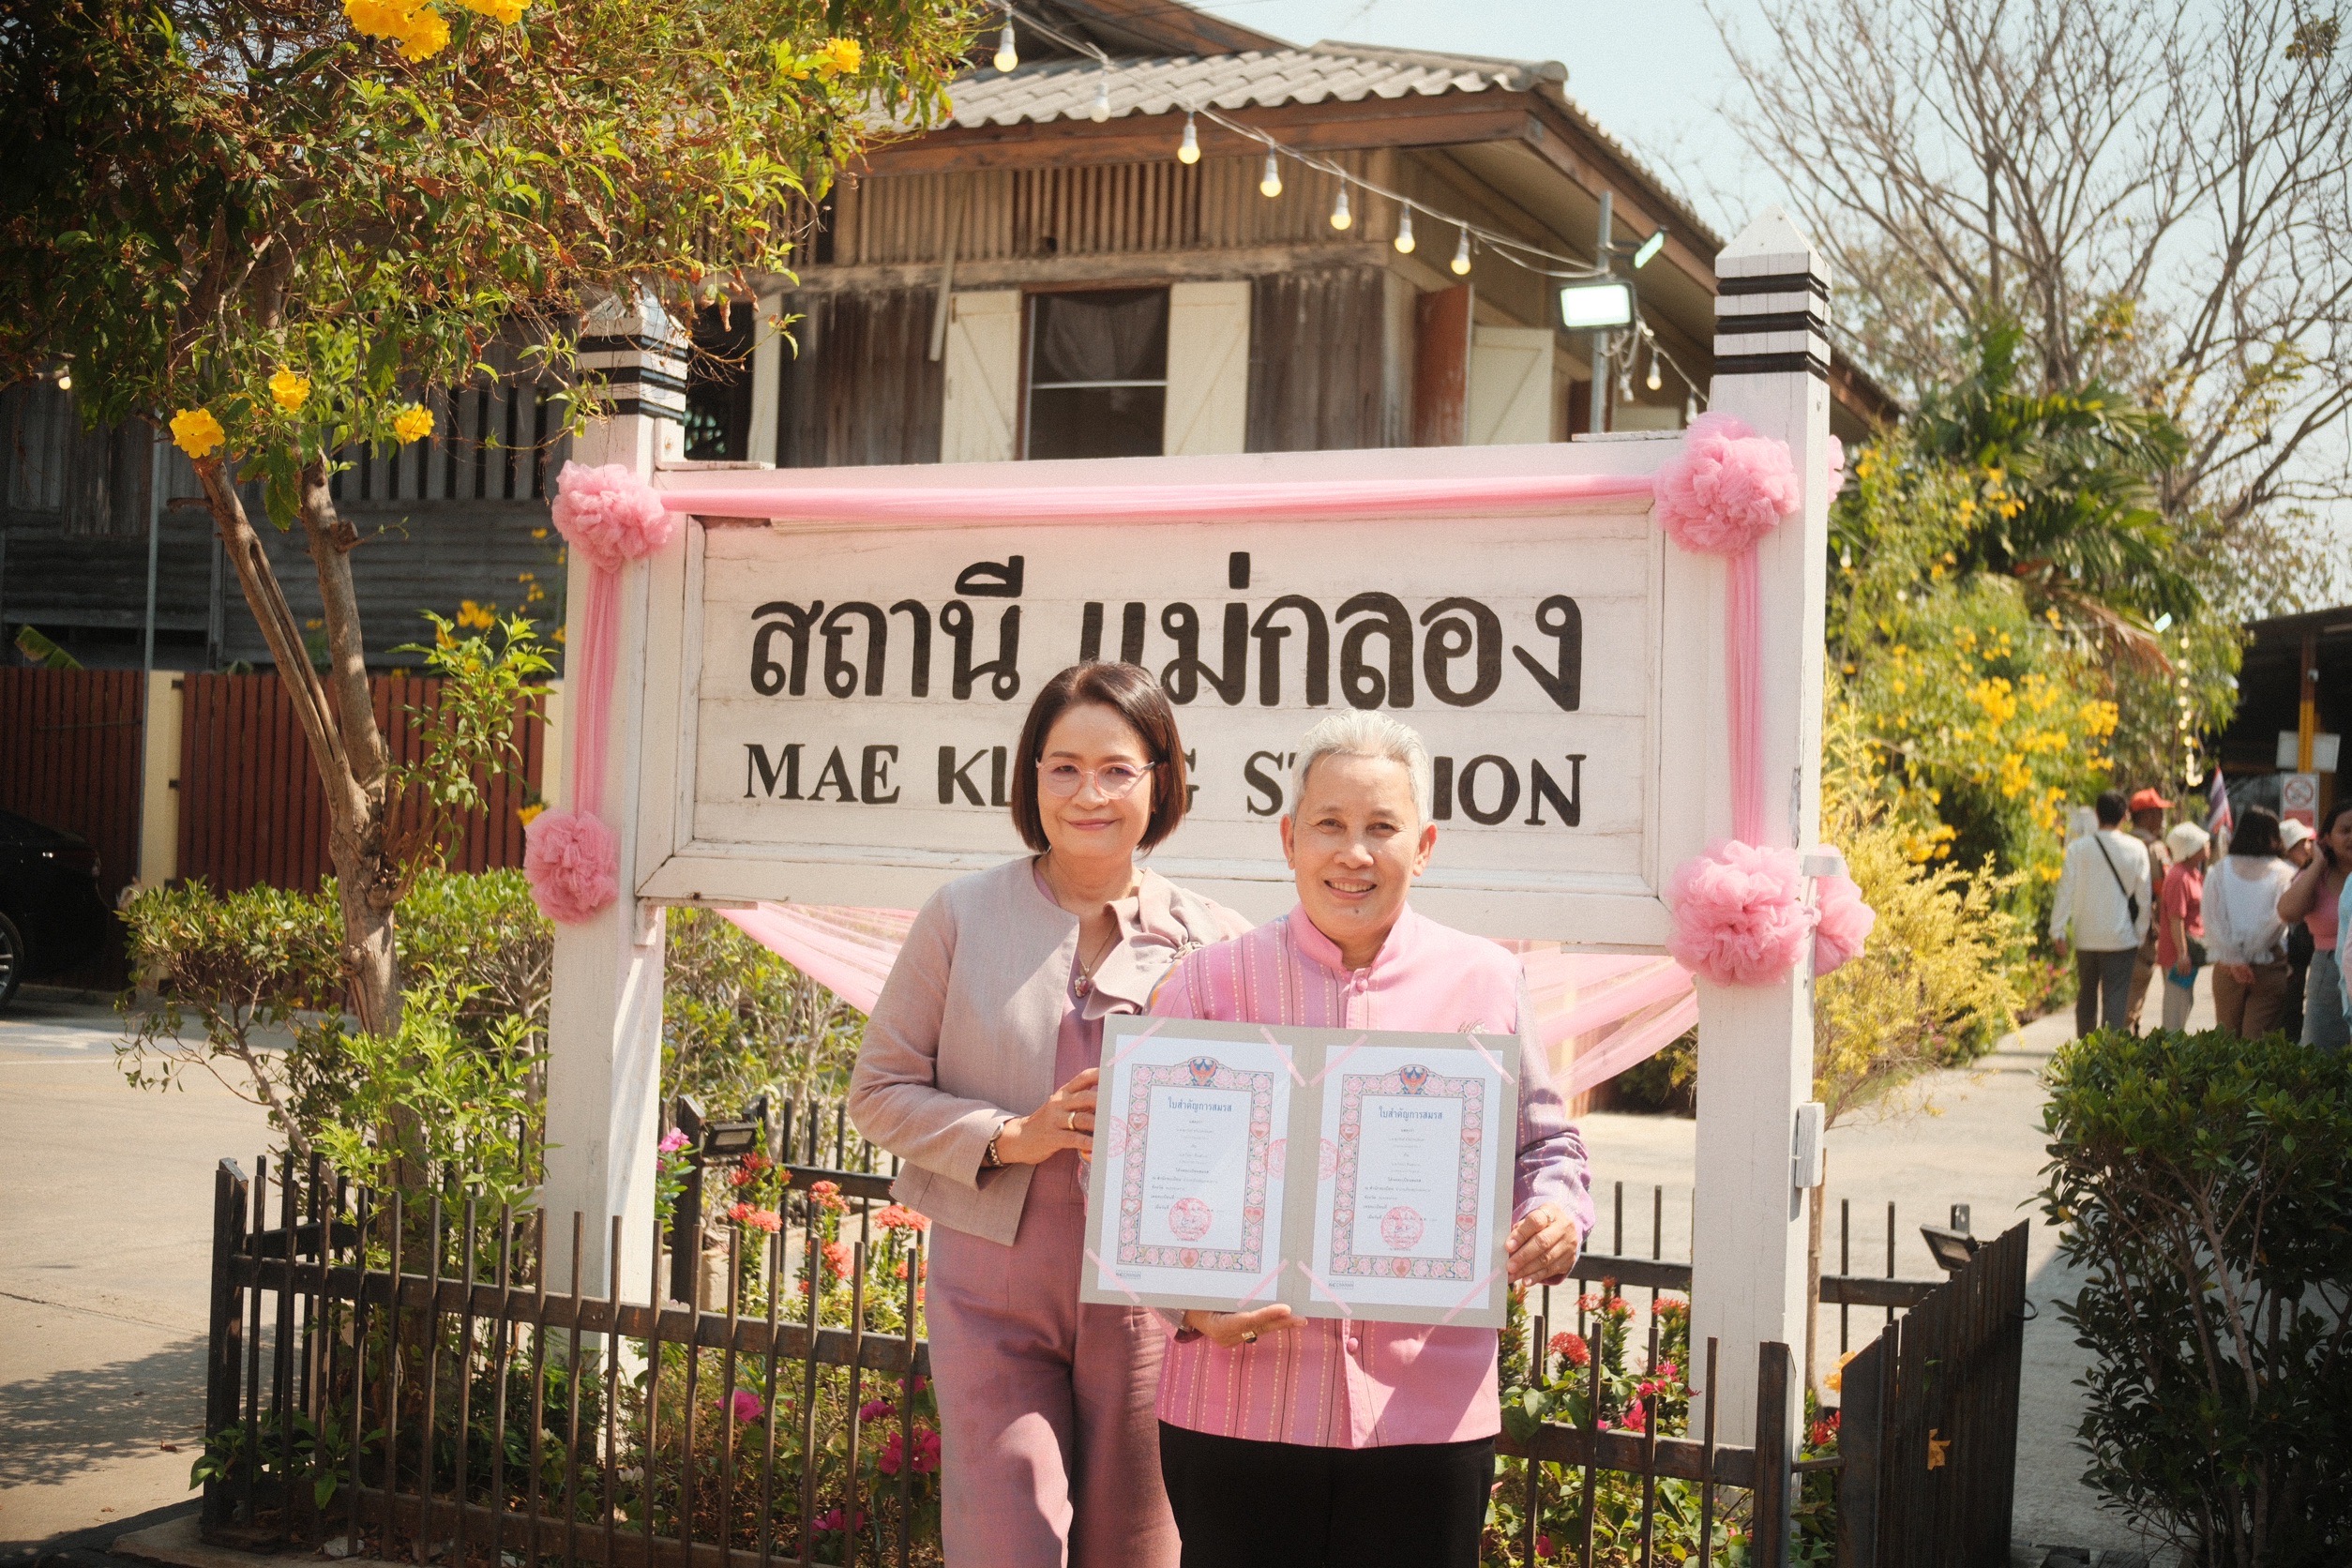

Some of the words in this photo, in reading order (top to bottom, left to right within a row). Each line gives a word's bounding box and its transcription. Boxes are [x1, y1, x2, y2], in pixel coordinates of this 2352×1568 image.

[749, 555, 1024, 702] สถานี
[1079, 551, 1583, 712] แม่กลอง
[744, 743, 901, 805] MAE
[1244, 750, 1587, 827] SION
[1168, 1096, 1232, 1113] ใบสำคัญการสมรส
[1379, 1106, 1443, 1122] ใบสำคัญการสมรส
